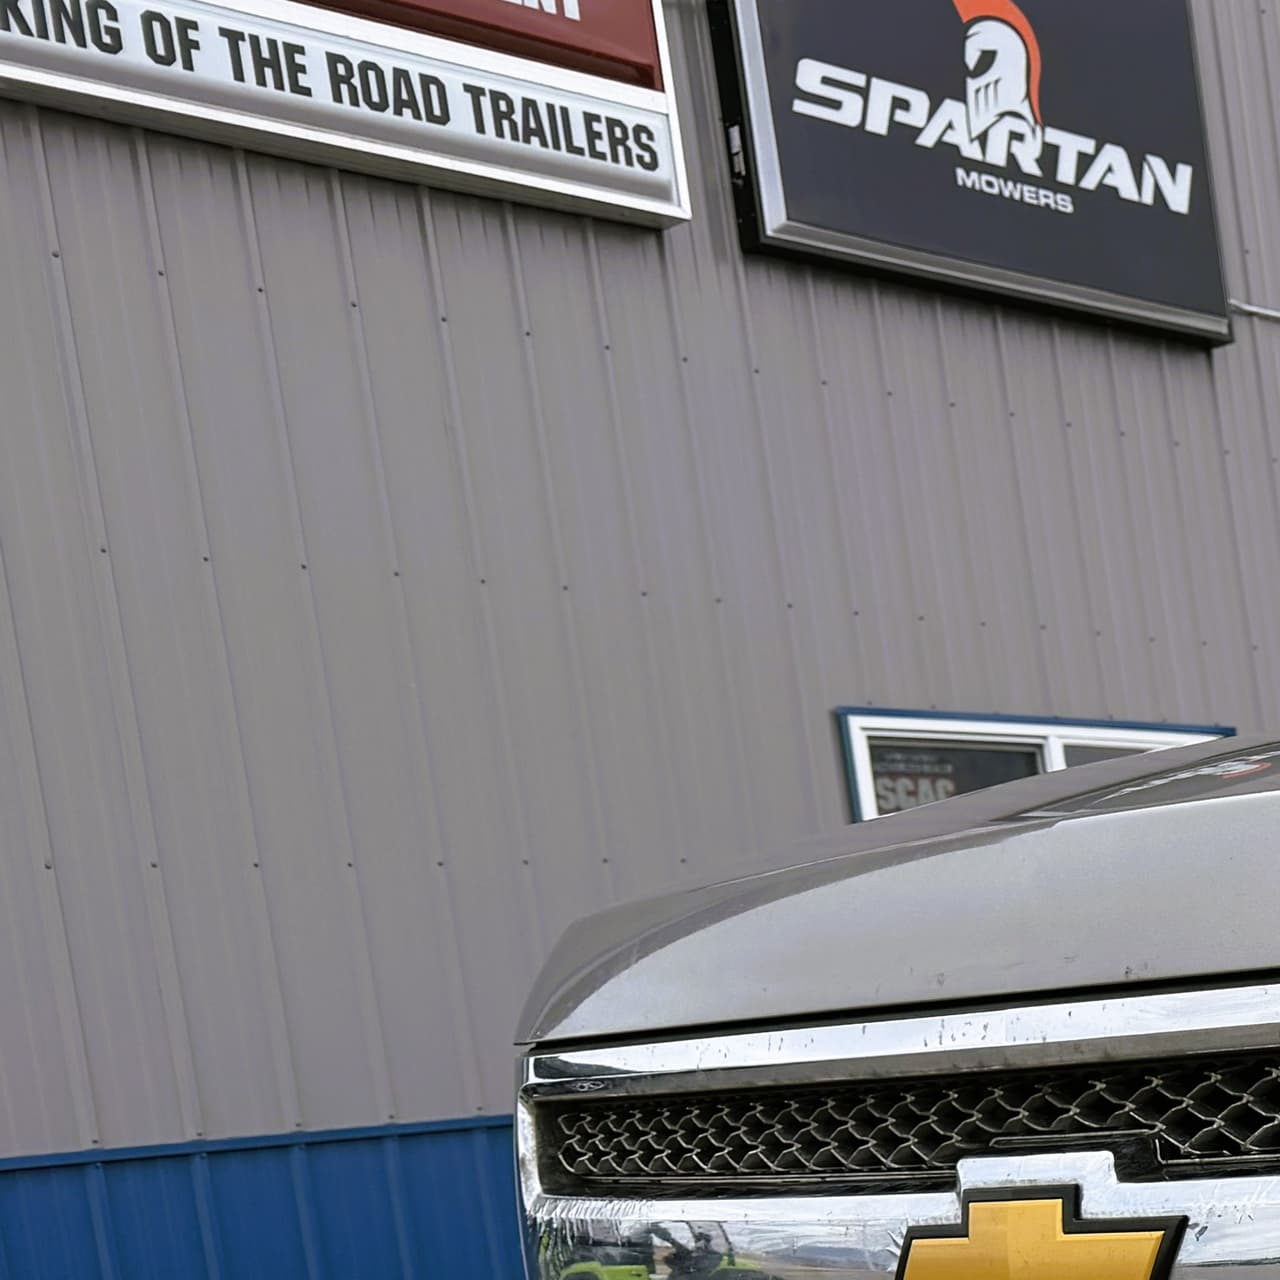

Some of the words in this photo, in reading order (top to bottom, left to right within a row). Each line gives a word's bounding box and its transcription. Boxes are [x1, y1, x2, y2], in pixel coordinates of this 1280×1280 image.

[0, 0, 123, 55] KING
[141, 10, 201, 71] OF
[219, 27, 312, 97] THE
[326, 51, 451, 126] ROAD
[462, 83, 659, 172] TRAILERS
[792, 57, 1193, 215] SPARTAN
[955, 167, 1074, 213] MOWERS
